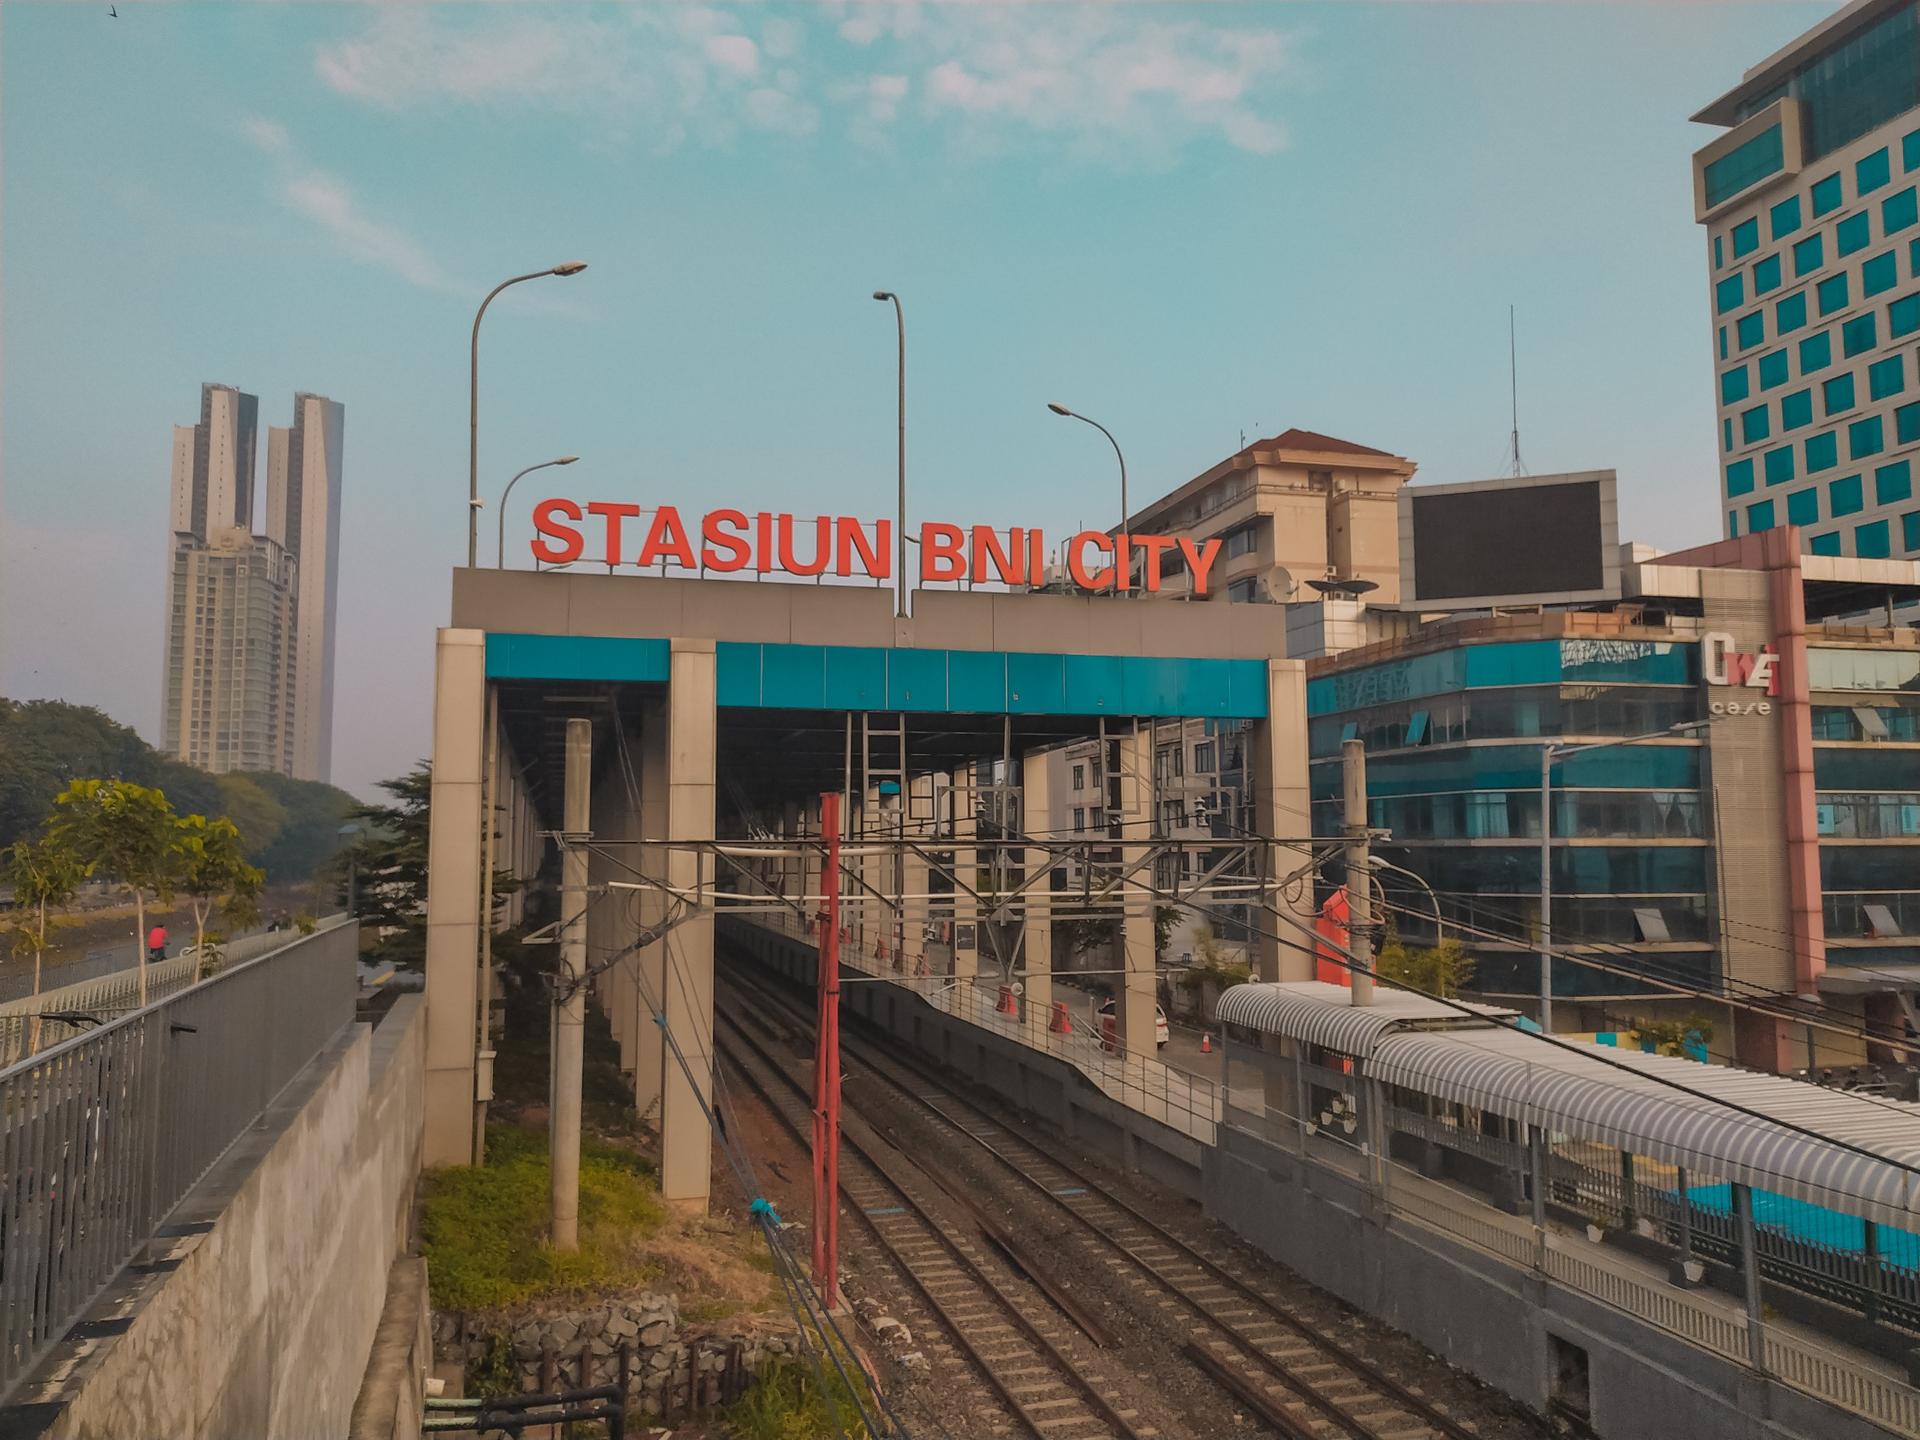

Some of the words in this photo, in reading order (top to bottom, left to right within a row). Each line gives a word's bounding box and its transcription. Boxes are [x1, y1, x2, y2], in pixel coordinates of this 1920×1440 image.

[530, 498, 891, 579] STASIUN
[921, 522, 1043, 587] BNI
[1069, 530, 1223, 594] CITY
